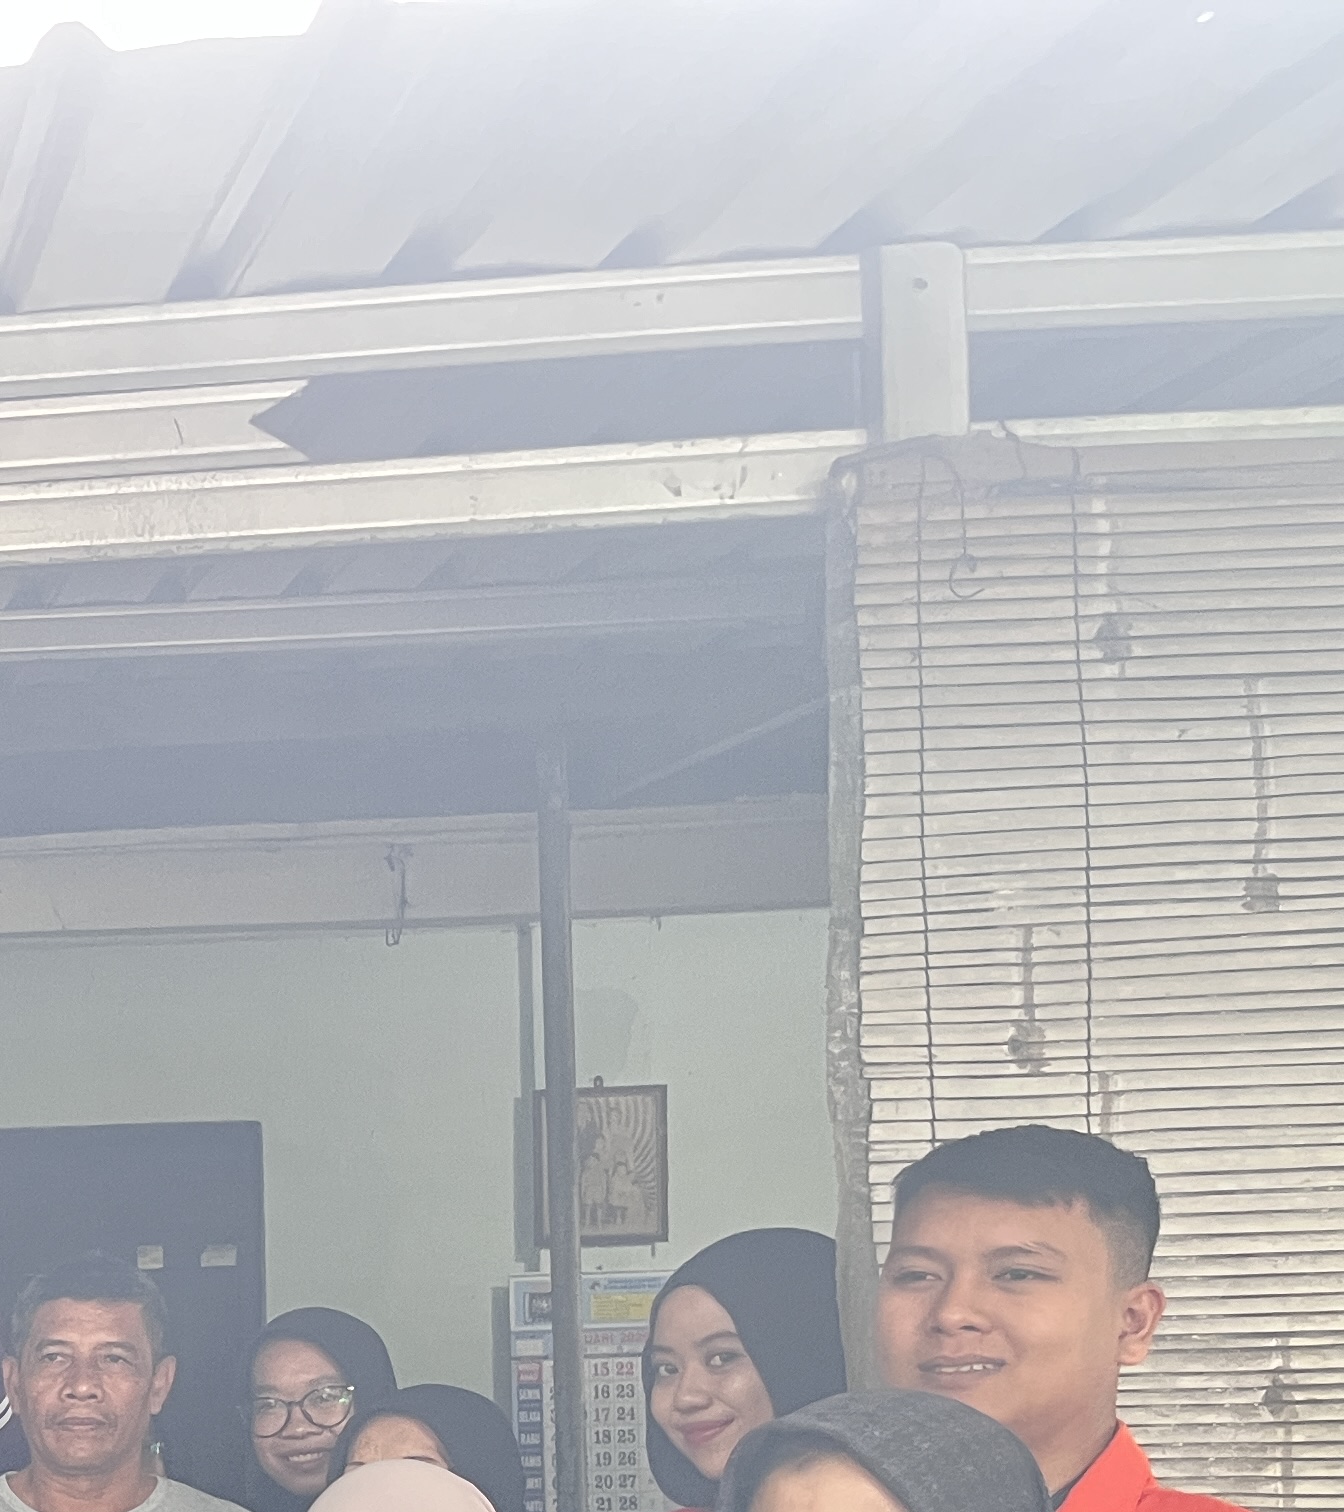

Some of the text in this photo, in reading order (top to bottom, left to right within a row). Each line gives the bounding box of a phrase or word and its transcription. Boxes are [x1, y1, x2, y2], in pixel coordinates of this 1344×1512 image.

[592, 1361, 634, 1377] 15 22
[593, 1384, 610, 1399] 16
[616, 1383, 635, 1398] 23
[593, 1407, 611, 1422] 17
[616, 1407, 636, 1421] 24
[594, 1429, 611, 1444] 18
[617, 1429, 636, 1444] 25
[595, 1451, 612, 1467] 19
[618, 1451, 637, 1466] 26
[594, 1474, 637, 1489] 20 27
[596, 1496, 612, 1512] 21
[619, 1495, 638, 1511] 28
